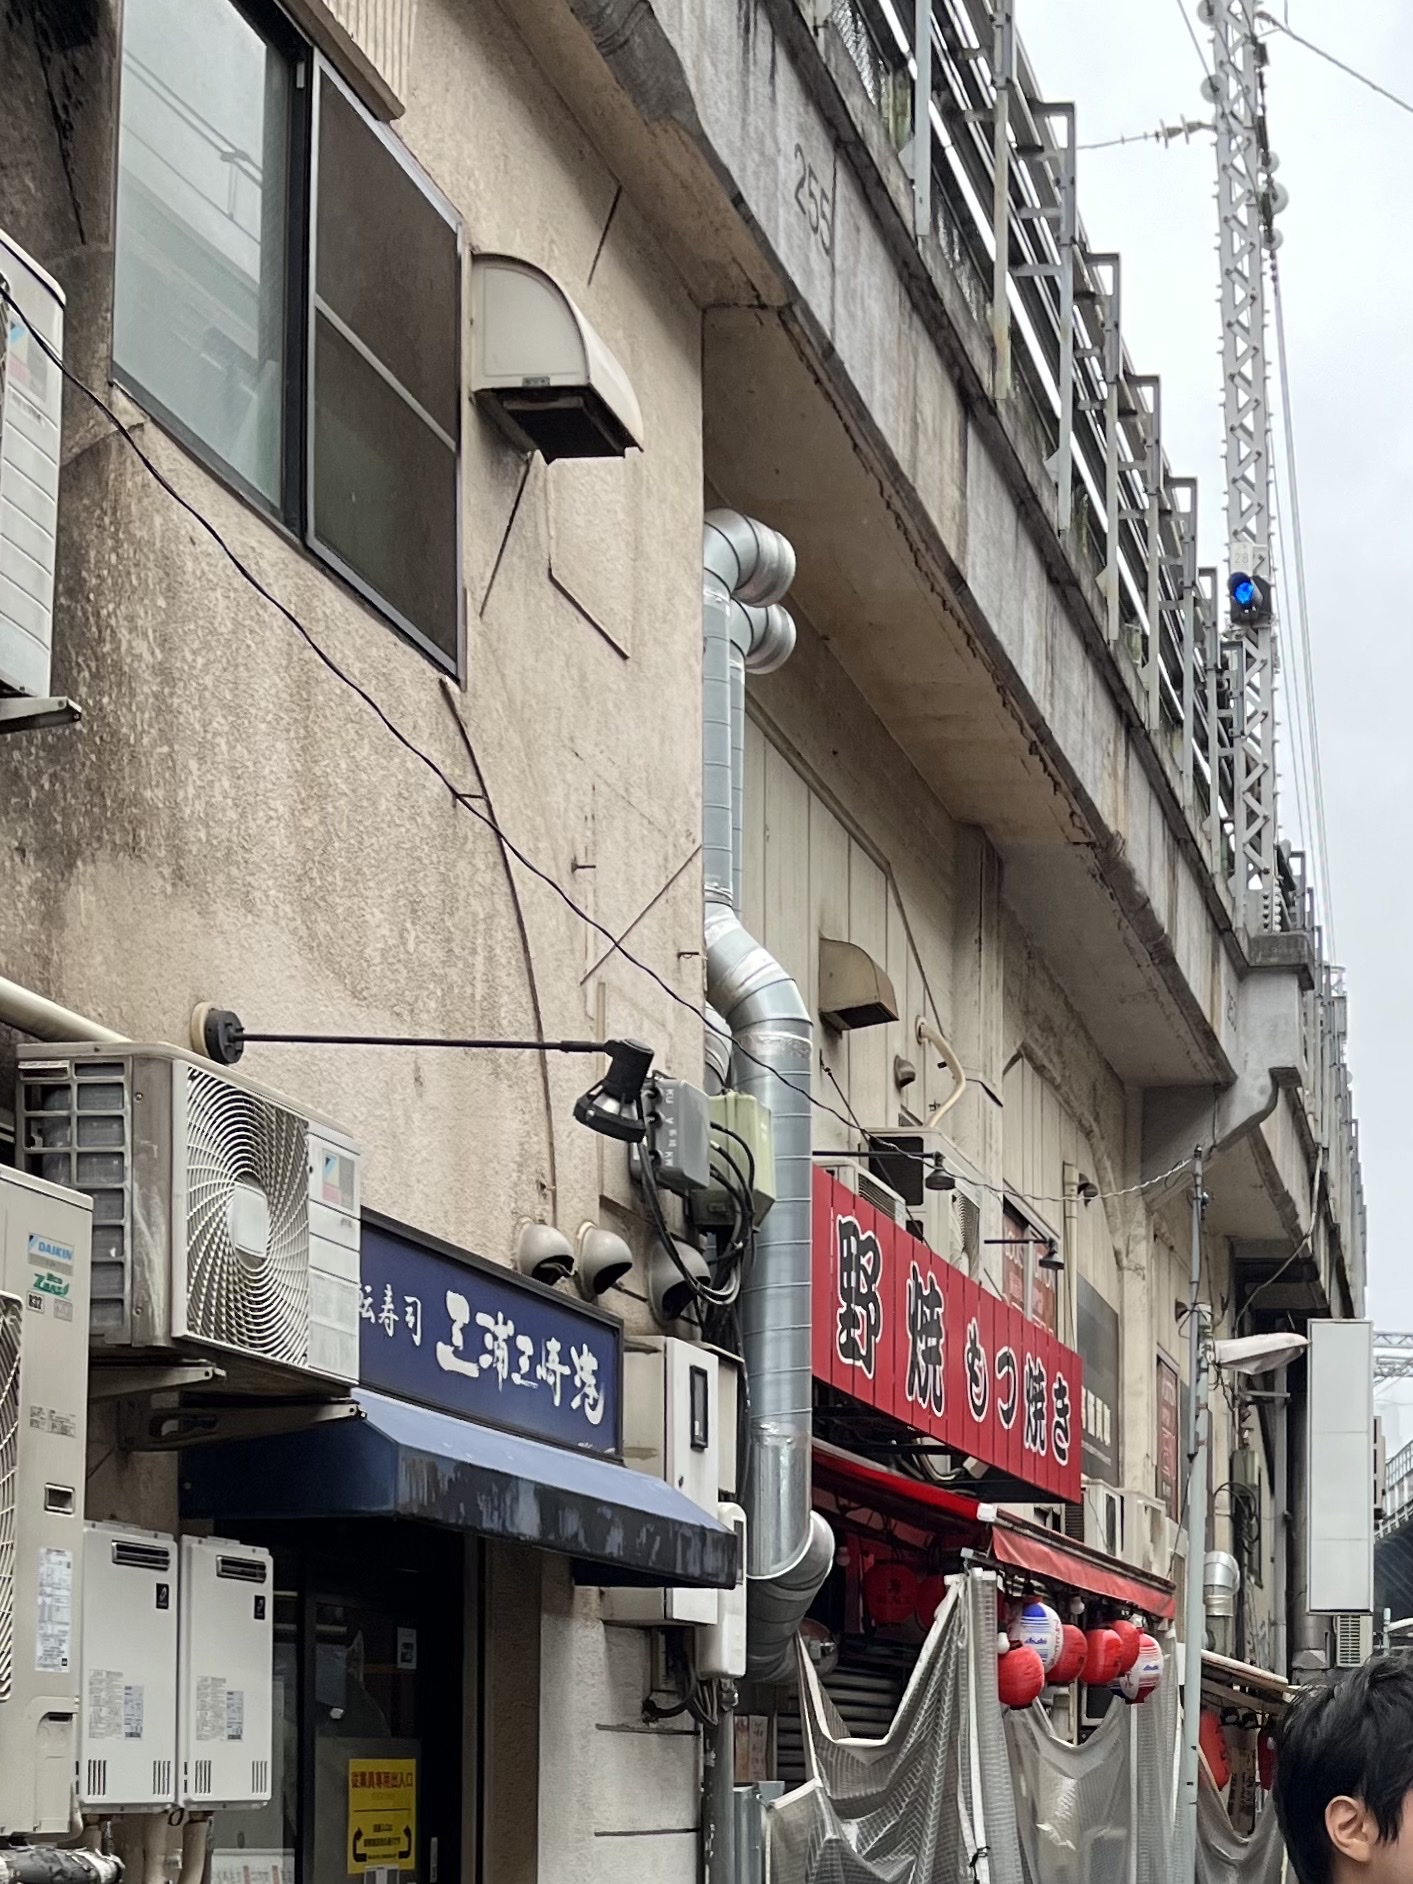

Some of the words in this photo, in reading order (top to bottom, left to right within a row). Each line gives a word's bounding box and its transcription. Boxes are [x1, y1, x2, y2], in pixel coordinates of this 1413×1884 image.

[38, 1241, 72, 1260] DAIKIN
[836, 1215, 945, 1418] 野焼
[964, 1318, 1072, 1467] もつ焼き
